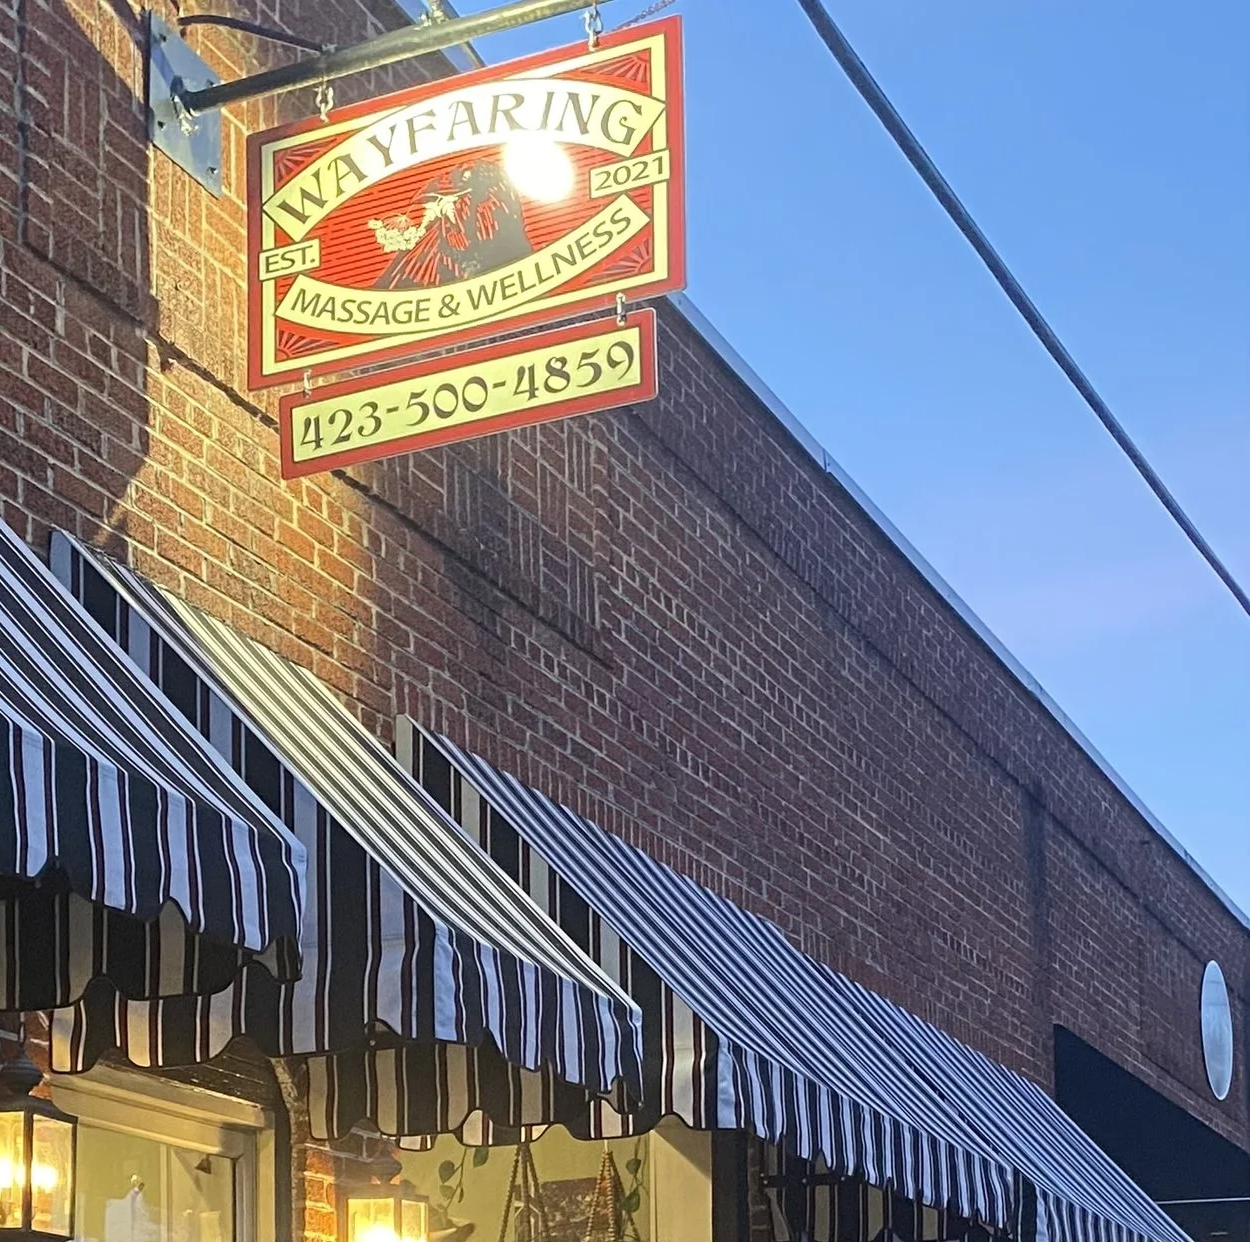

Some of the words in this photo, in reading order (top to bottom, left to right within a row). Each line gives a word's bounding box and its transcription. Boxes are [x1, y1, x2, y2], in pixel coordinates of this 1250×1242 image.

[277, 91, 643, 226] WAYFARING
[594, 155, 665, 191] 2021
[264, 245, 317, 275] EST.
[291, 288, 431, 326] MASSAGE
[438, 291, 462, 317] &
[466, 205, 632, 307] WELLNESS
[299, 341, 636, 451] 423-500-4859
